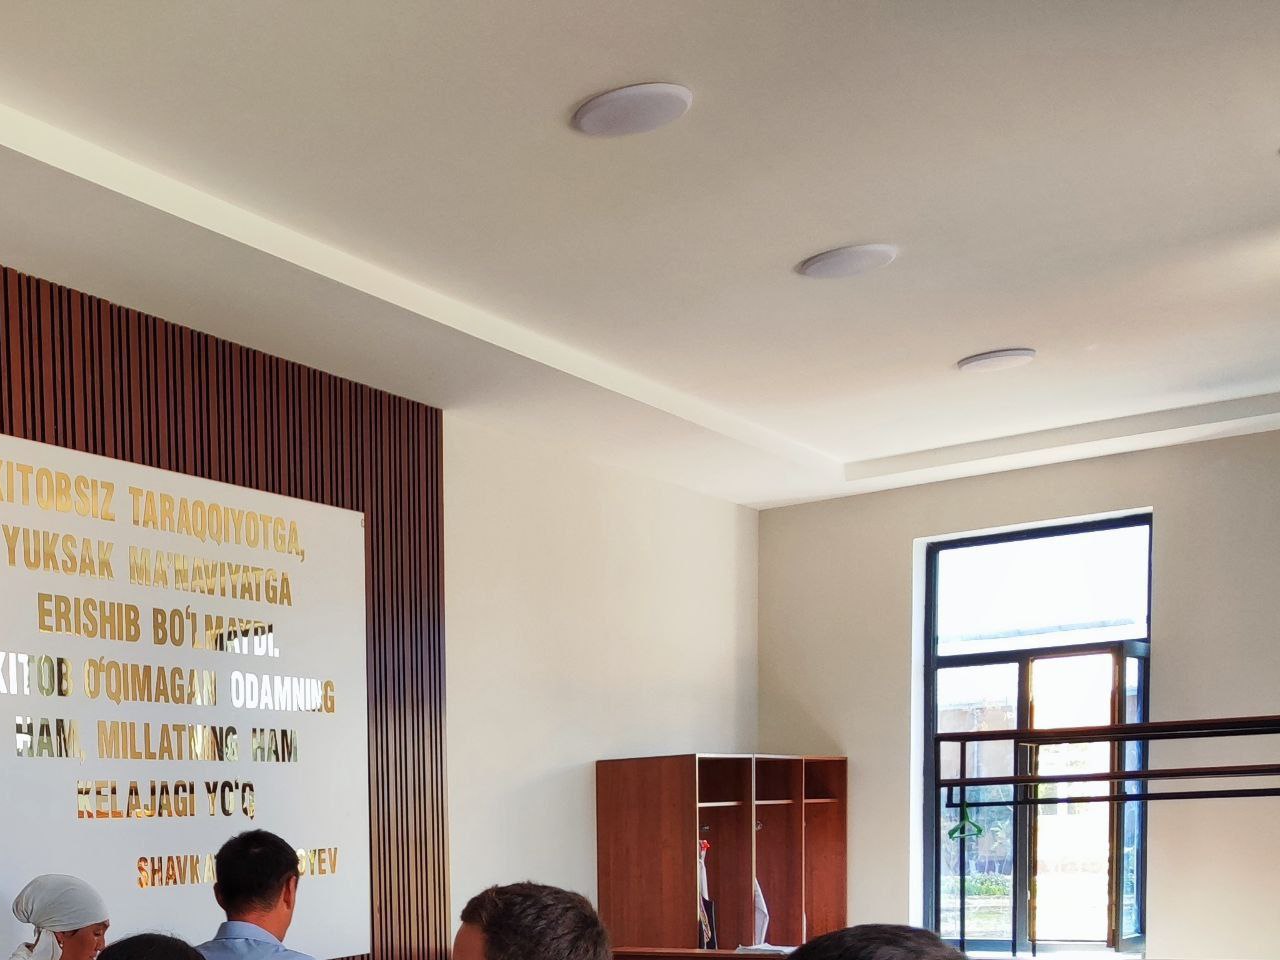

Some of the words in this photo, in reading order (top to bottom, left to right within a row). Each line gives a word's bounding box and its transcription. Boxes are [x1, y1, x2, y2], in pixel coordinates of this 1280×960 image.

[128, 485, 306, 562] TARAQQIYOTGA,
[1, 523, 115, 580] YUKSAK
[128, 545, 293, 607] MA'NAVIYATGA
[37, 592, 141, 643] ERISHIB
[84, 656, 217, 706] O'QIMAGAN
[230, 670, 335, 714] ODAMNING
[15, 715, 86, 765] HAM,
[97, 719, 239, 762] MILLATNING
[251, 727, 299, 763] HAM
[77, 780, 195, 819] KELAJAGI
[137, 852, 217, 889] SHAVKA
